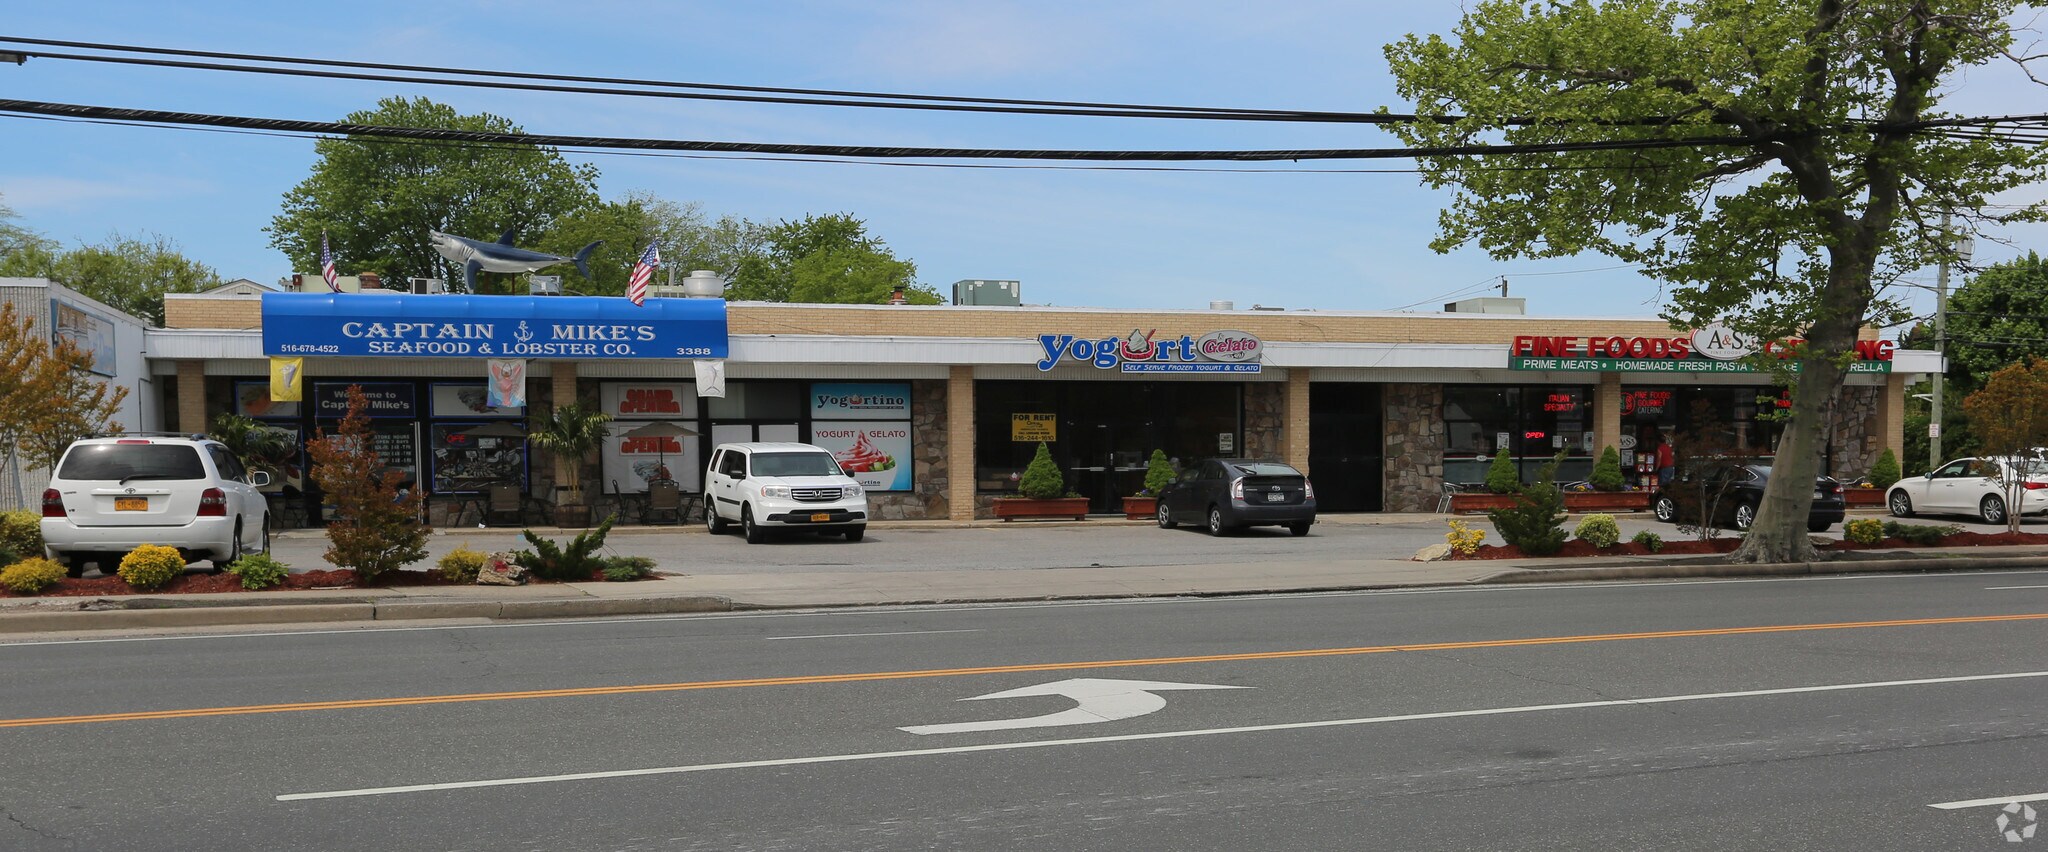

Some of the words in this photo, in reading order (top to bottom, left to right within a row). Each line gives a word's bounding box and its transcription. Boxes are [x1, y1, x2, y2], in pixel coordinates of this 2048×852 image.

[342, 322, 494, 339] CAPTAIN
[551, 324, 656, 341] MIKE'S
[281, 344, 339, 353] 516-678-4522
[368, 341, 471, 354] SEAFOOD
[477, 342, 494, 354] &
[502, 343, 598, 355] LOBSTER
[603, 344, 636, 355] CO.
[1204, 338, 1257, 354] Gelato
[1513, 336, 1577, 358] FINE
[1588, 336, 1690, 360] FOODS
[677, 347, 711, 355] 3388
[1523, 360, 1556, 369] PRIME
[1561, 360, 1598, 370] MEATS
[1616, 361, 1674, 370] HOMEMADE
[1678, 361, 1712, 371] FRESH
[385, 390, 396, 399] to
[372, 400, 410, 409] Mike's
[816, 430, 855, 438] YOGURT
[869, 430, 906, 438] GELATO
[1525, 431, 1545, 439] OPEN
